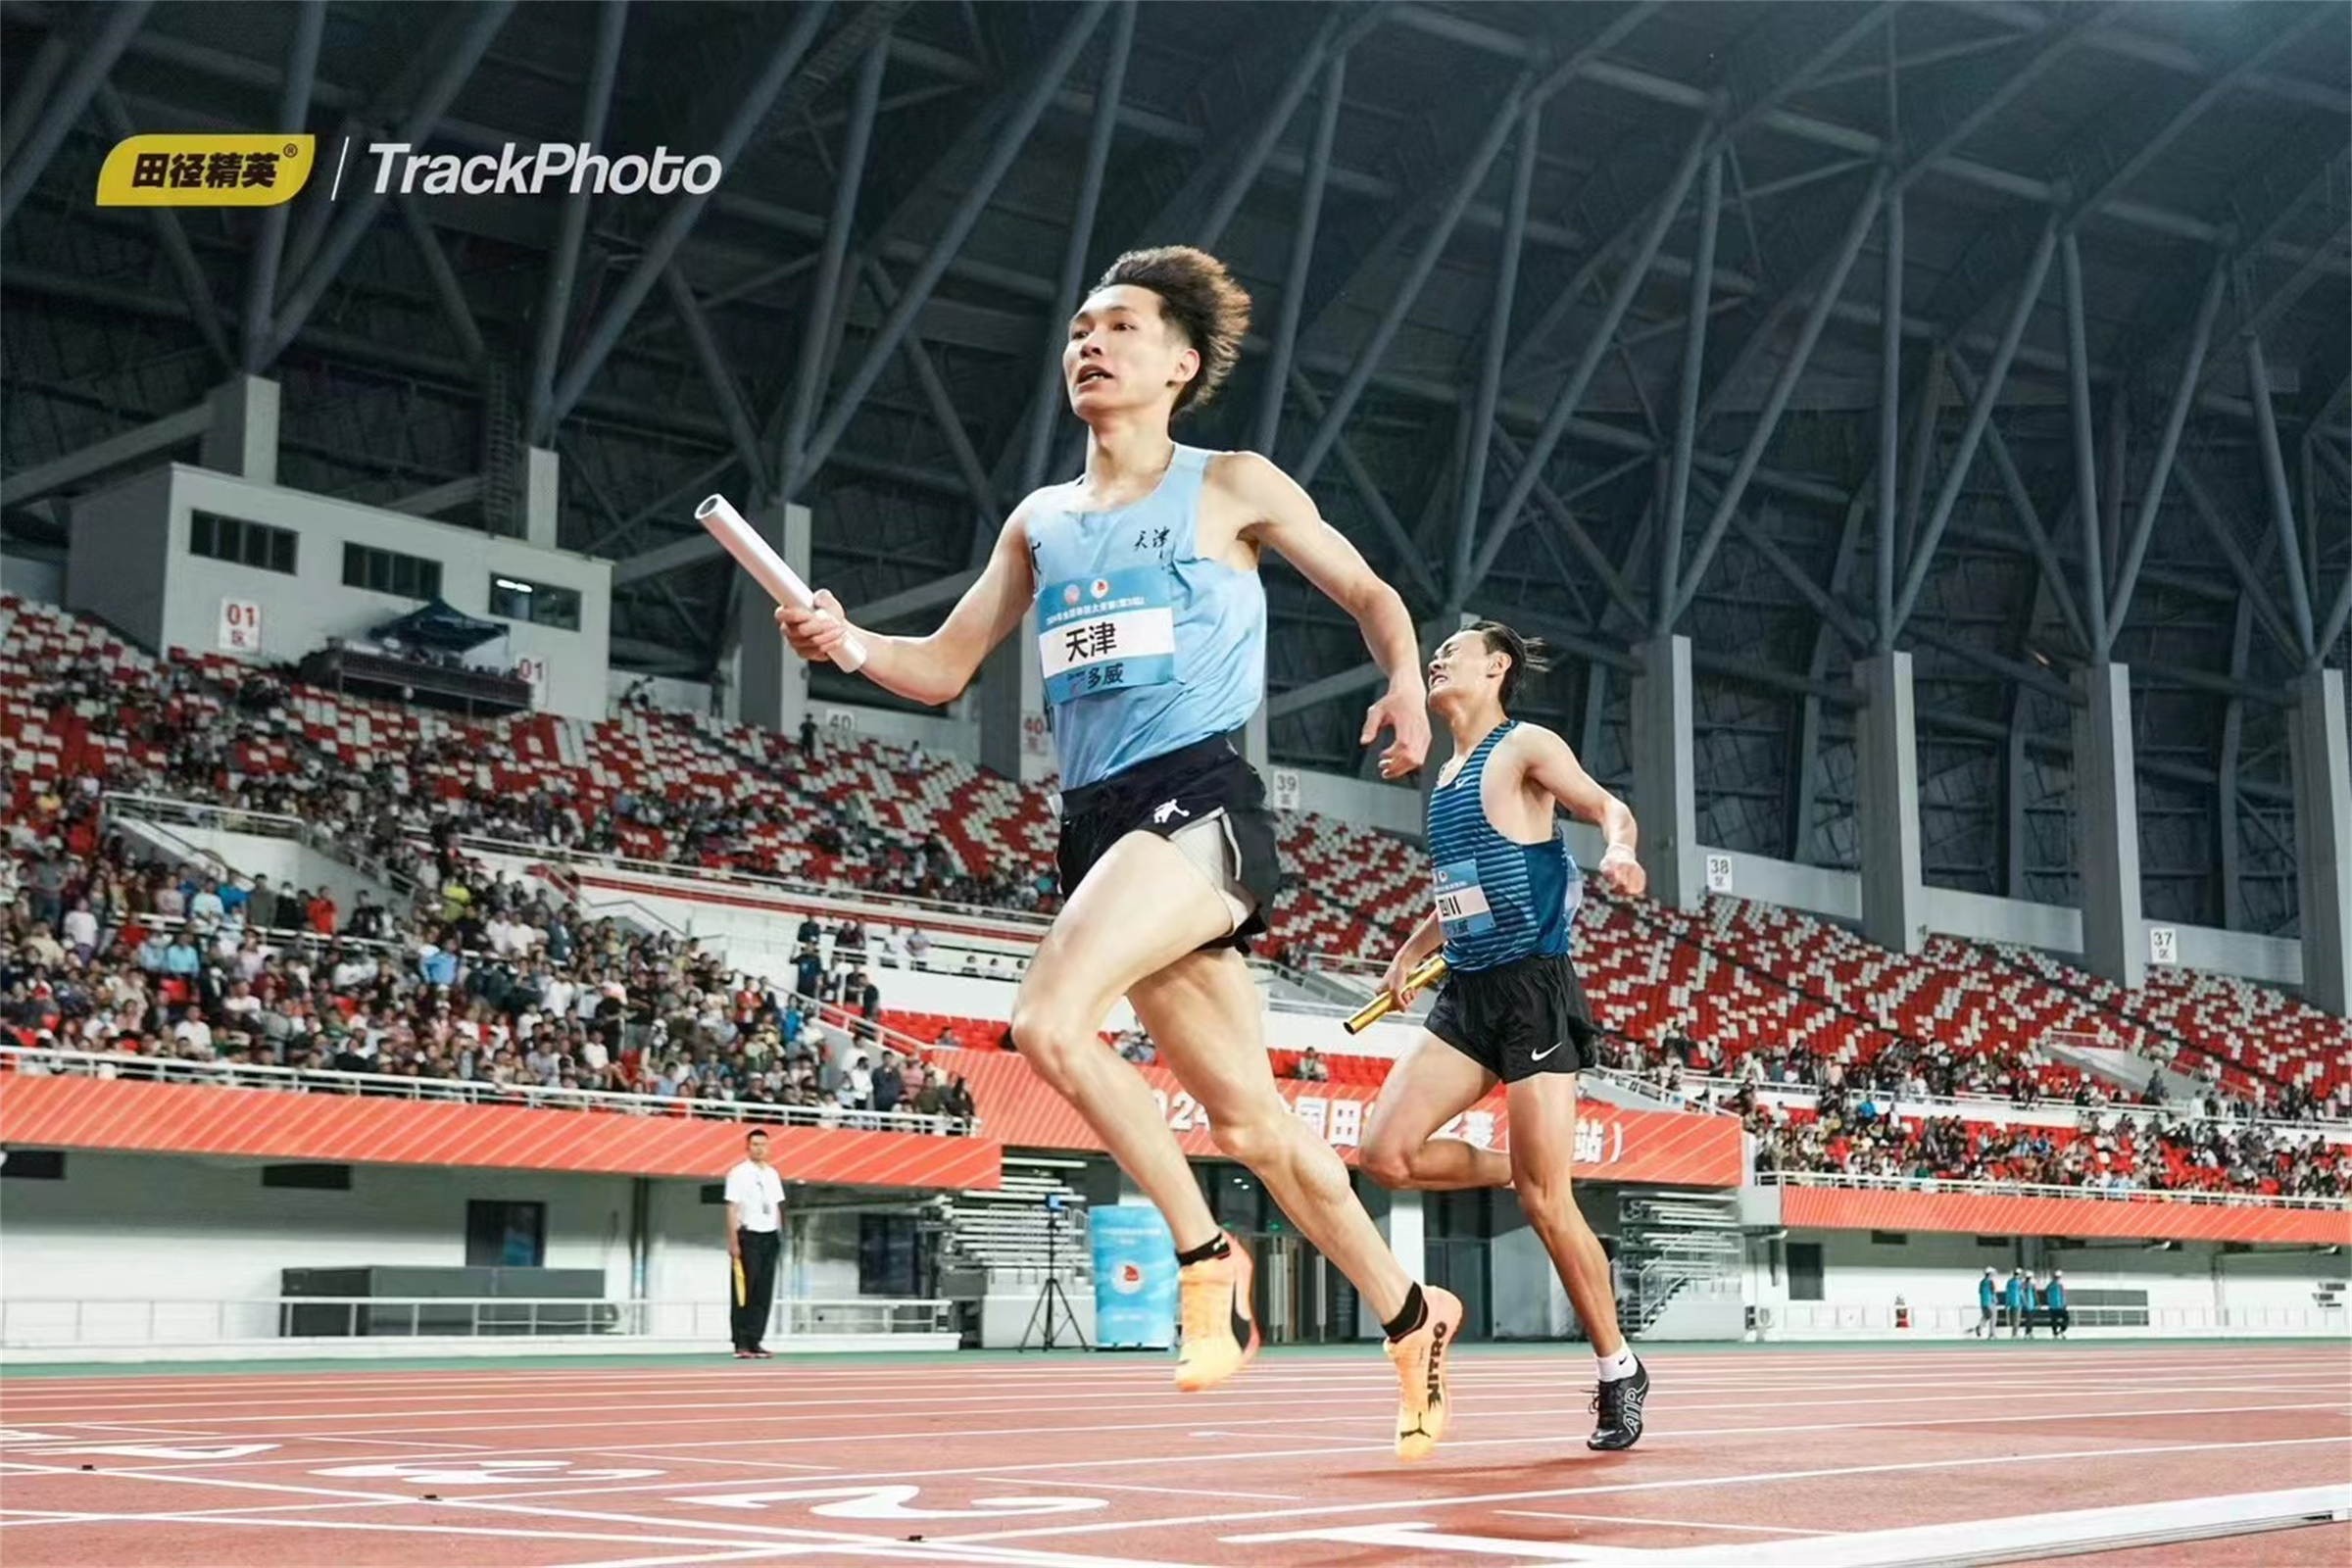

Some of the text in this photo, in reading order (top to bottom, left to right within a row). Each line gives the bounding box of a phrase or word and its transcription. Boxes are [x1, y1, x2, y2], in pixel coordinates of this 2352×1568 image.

[226, 604, 254, 627] 01
[1065, 621, 1117, 662] 天津
[1088, 662, 1124, 690] 多威
[1277, 774, 1297, 791] 39
[1710, 858, 1729, 874] 38
[2154, 931, 2173, 947] 37
[1428, 1321, 1447, 1411] NITRO
[1623, 1384, 1645, 1437] AIR
[662, 1484, 1110, 1519] 2
